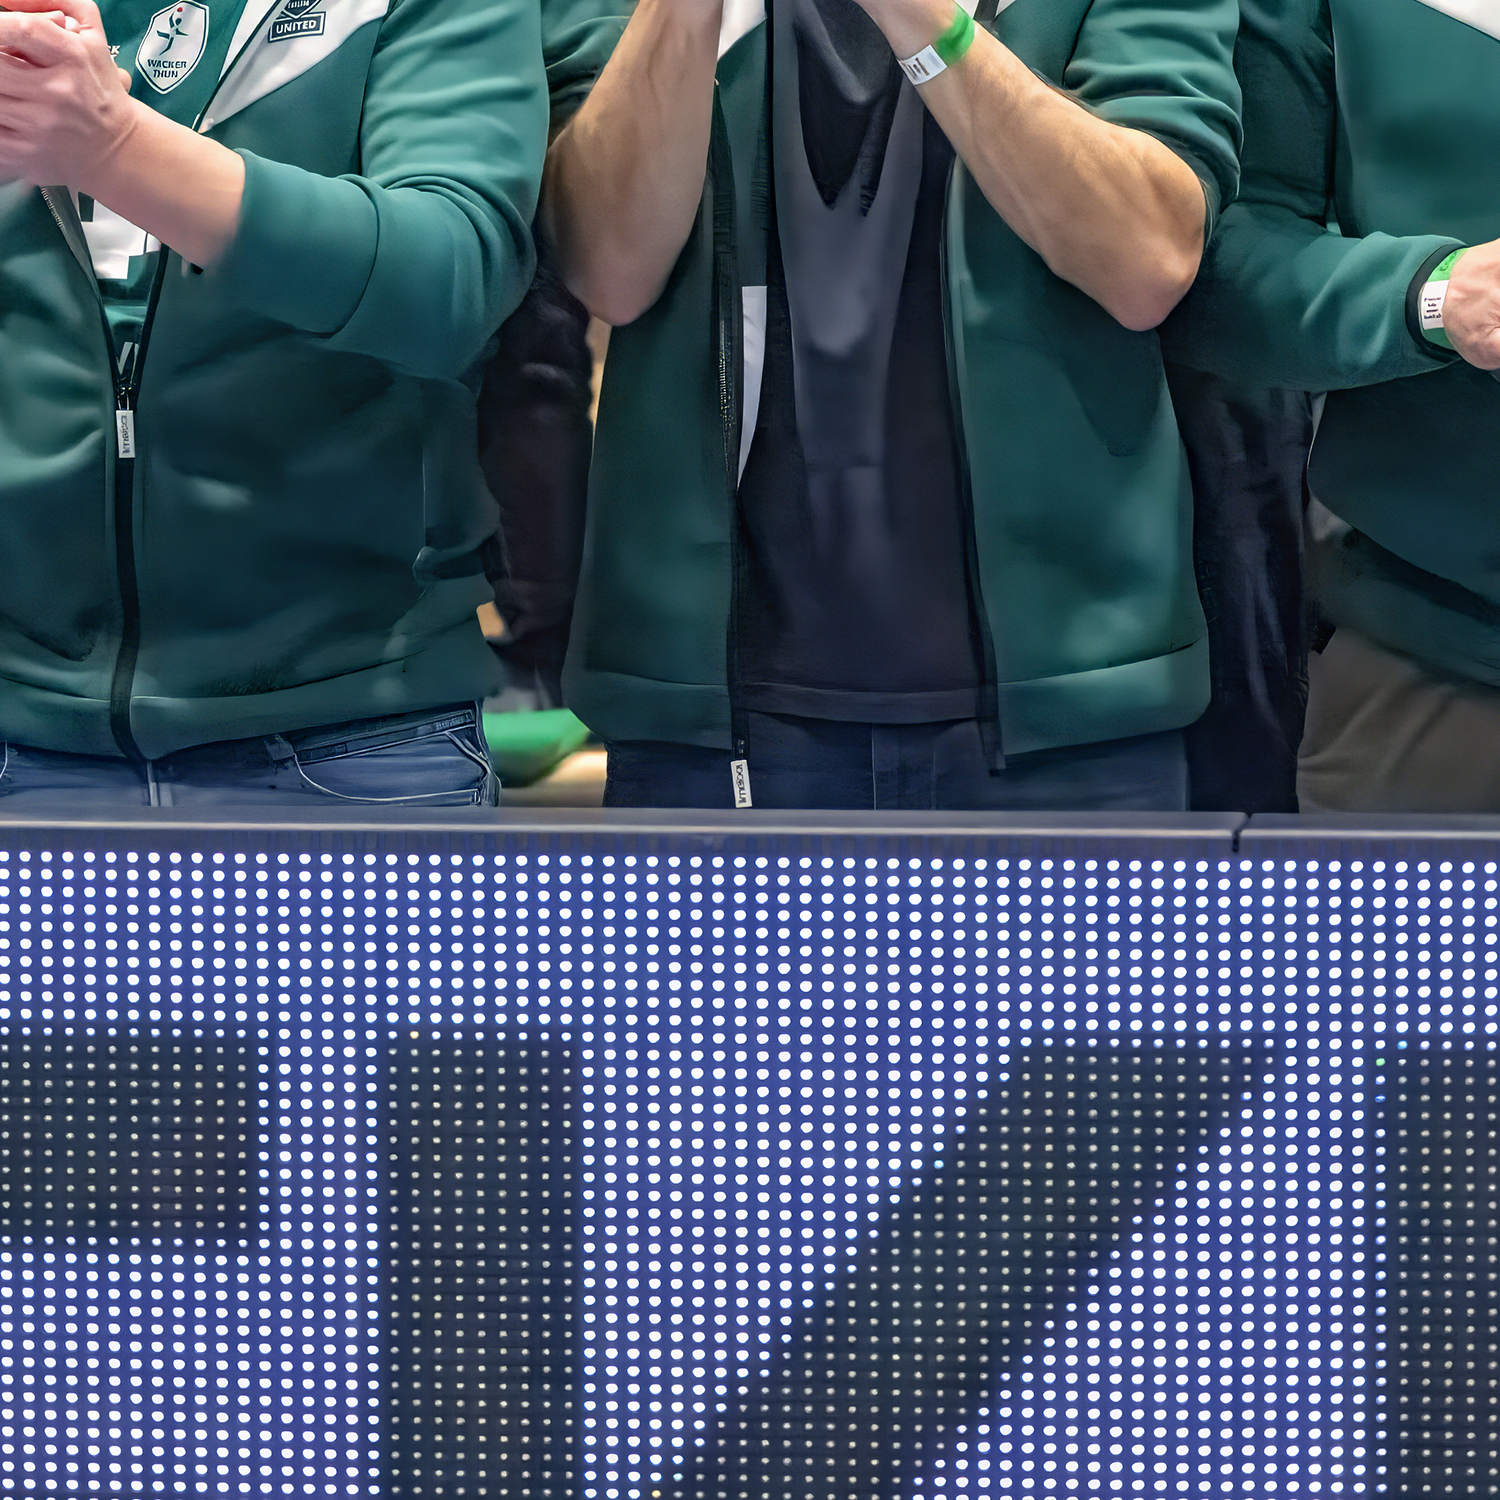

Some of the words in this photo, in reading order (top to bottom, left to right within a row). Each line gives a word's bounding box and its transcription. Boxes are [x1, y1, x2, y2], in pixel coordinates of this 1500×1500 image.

[276, 19, 317, 34] UNITED
[147, 58, 187, 70] WACKER
[153, 69, 179, 79] THUN
